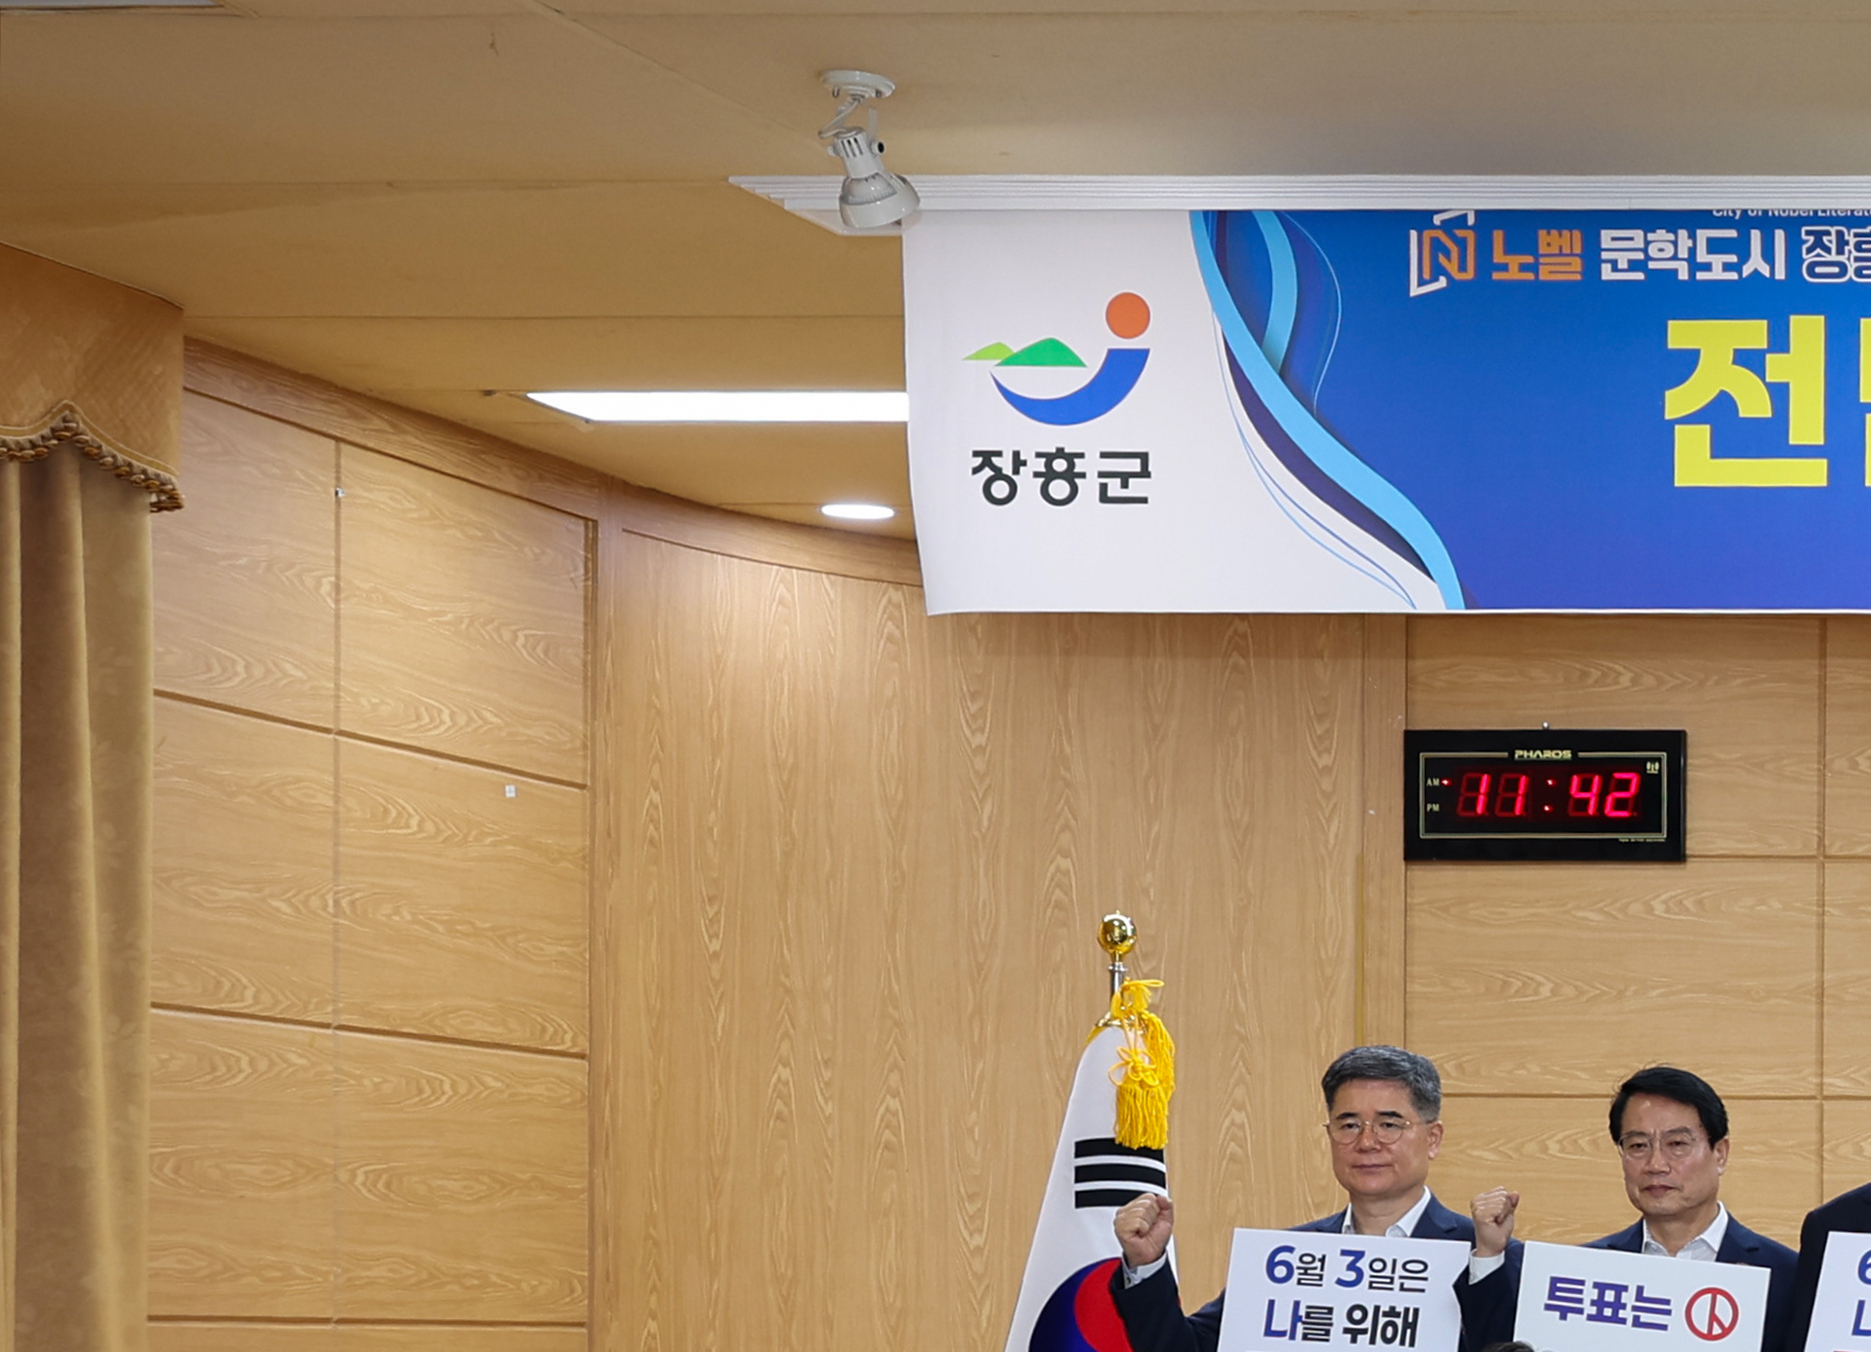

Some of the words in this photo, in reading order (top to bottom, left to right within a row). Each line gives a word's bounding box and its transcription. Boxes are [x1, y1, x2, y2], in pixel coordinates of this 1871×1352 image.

[1492, 228, 1582, 280] 노벨
[1600, 228, 1786, 281] 문학도시
[972, 447, 1151, 506] 장흥군
[1514, 750, 1572, 760] PHAROS
[1427, 778, 1440, 786] AM
[1475, 772, 1640, 818] 11:42
[1427, 803, 1440, 811] PM
[1266, 1245, 1326, 1287] 6월
[1335, 1249, 1428, 1293] 3일은
[1264, 1299, 1334, 1342] 나를
[1342, 1304, 1420, 1348] 위해
[1544, 1276, 1672, 1331] 투표는
